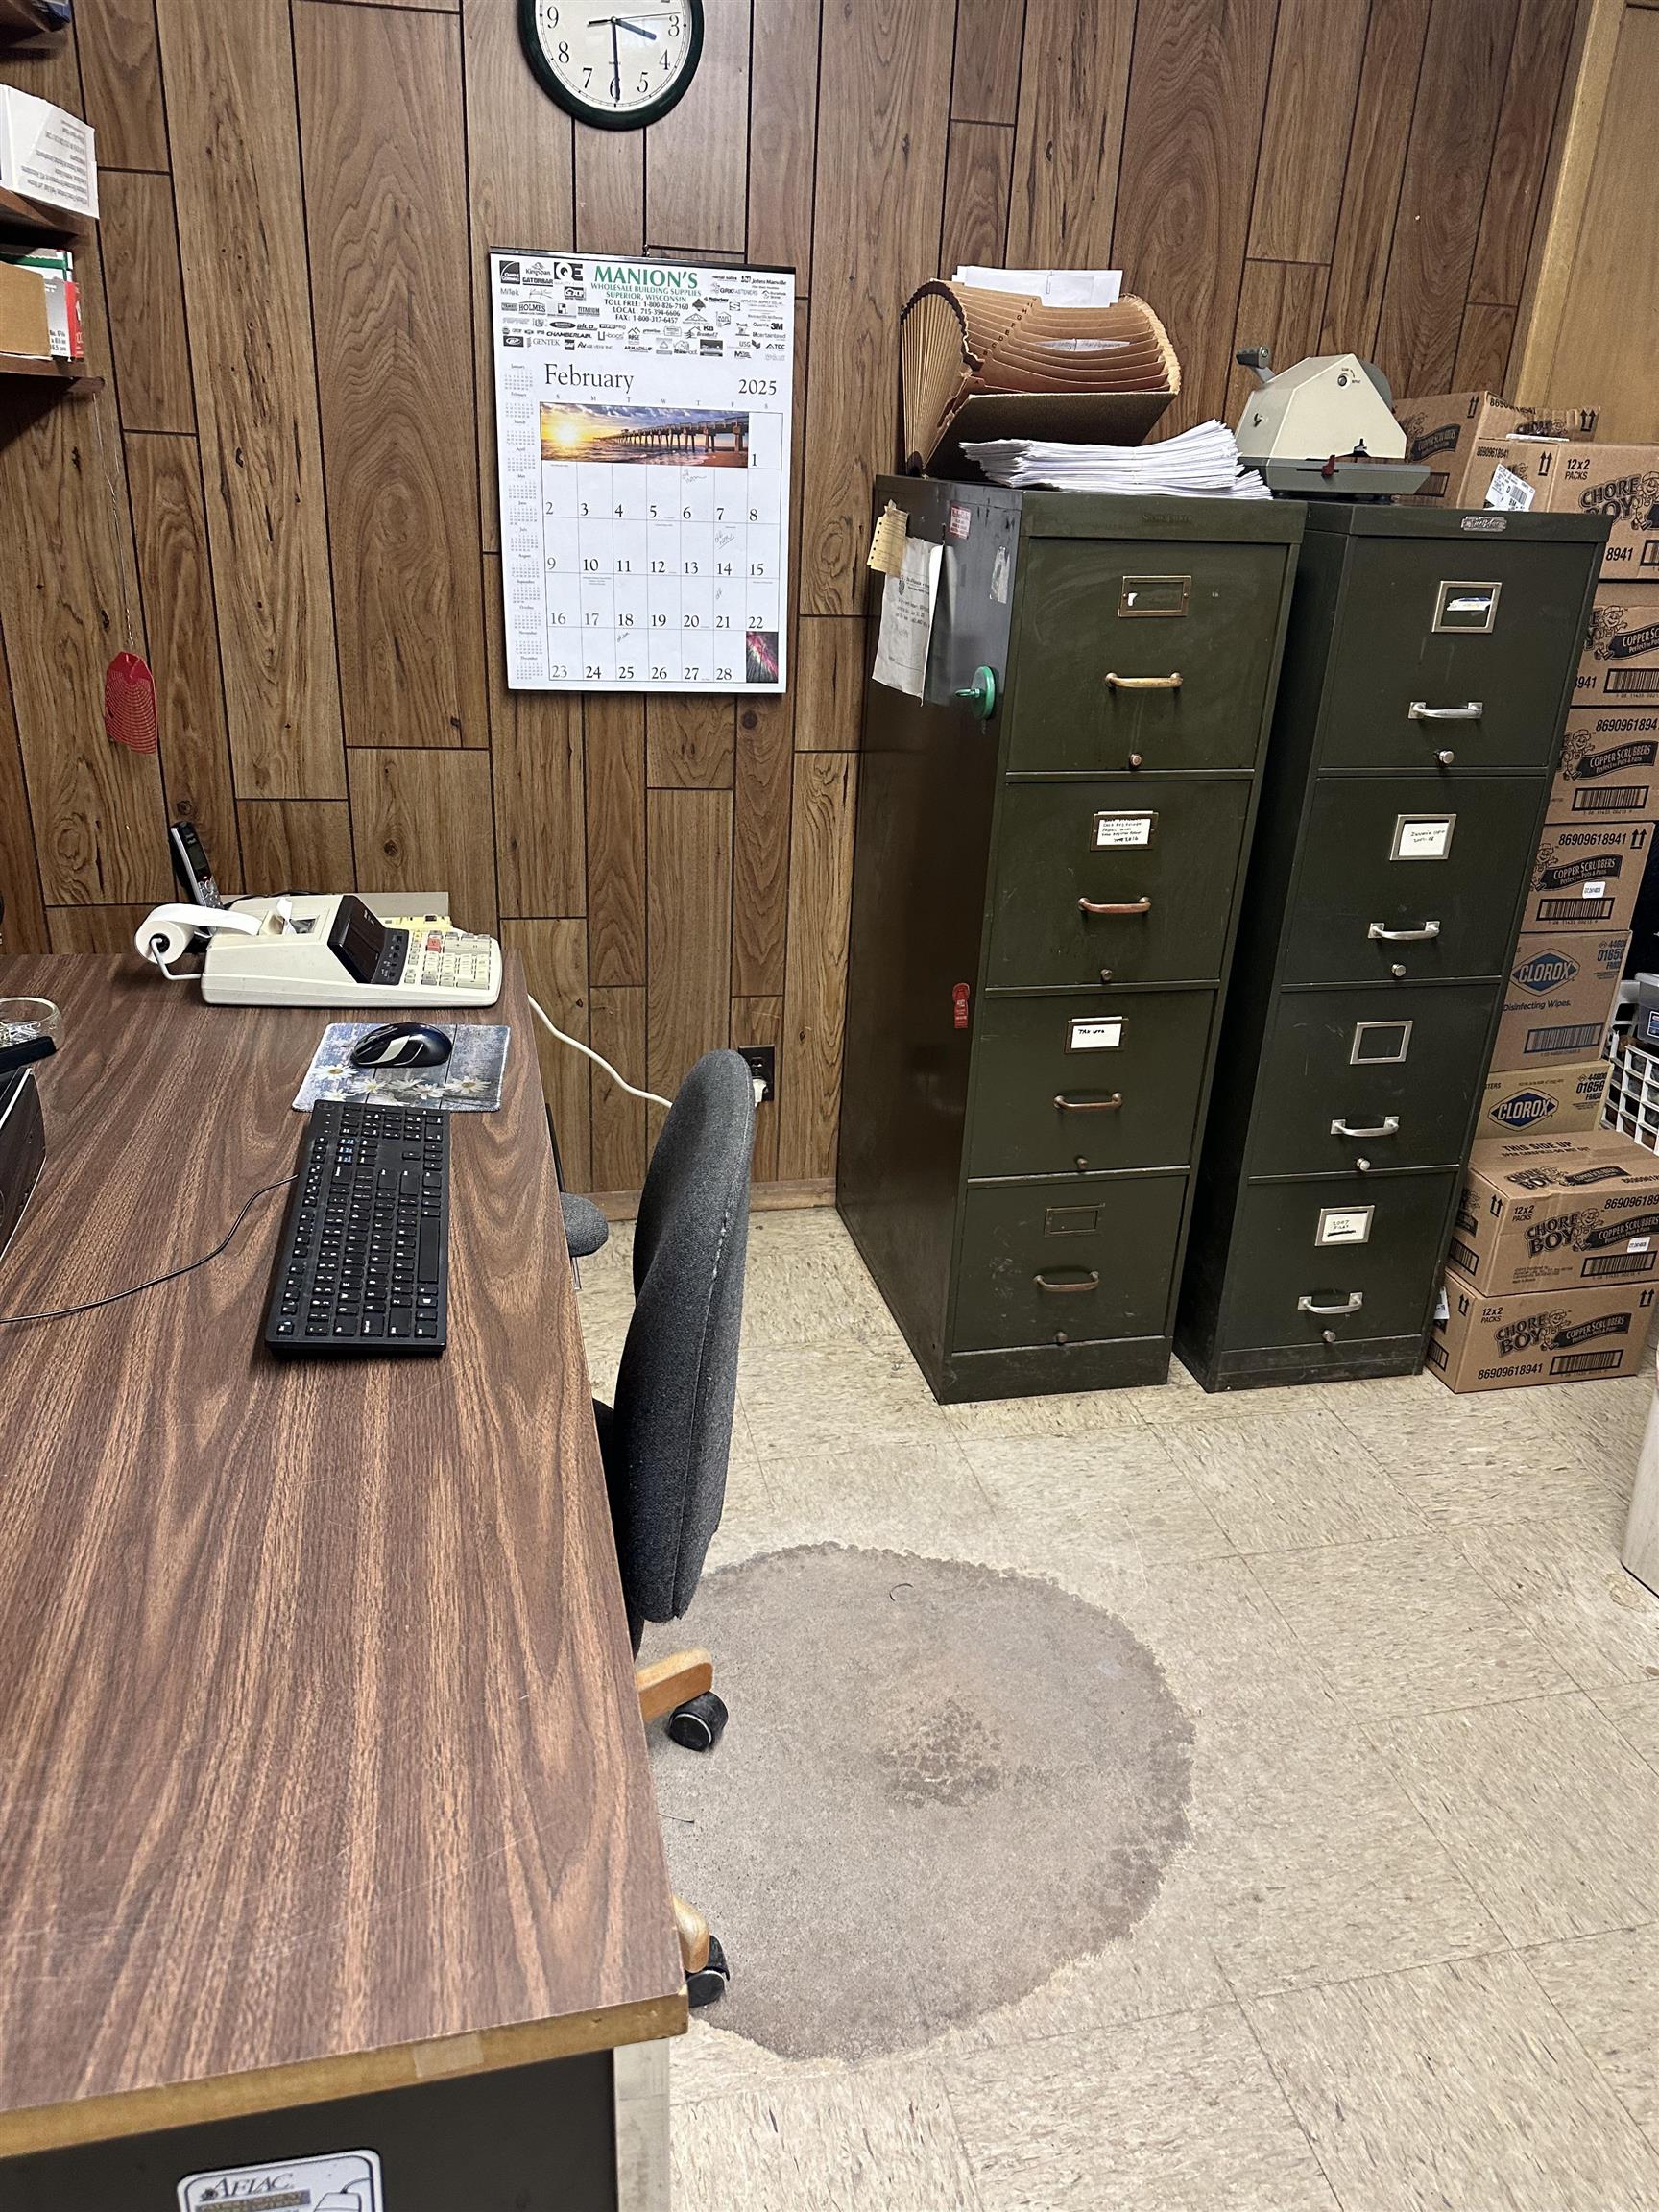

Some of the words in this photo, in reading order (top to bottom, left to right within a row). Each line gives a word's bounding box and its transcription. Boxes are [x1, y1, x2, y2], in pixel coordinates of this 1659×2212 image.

[547, 6, 558, 28] 9
[668, 14, 680, 37] 3
[558, 41, 569, 63] 8
[659, 49, 671, 70] 4
[582, 67, 592, 89] 7
[637, 72, 648, 93] 5
[595, 265, 698, 289] MANION'S
[591, 283, 632, 292] WHOLESALE
[635, 286, 668, 295] BUILDING
[670, 288, 702, 297] SUPPLIES
[544, 363, 634, 394] February
[738, 378, 777, 396] 2025
[752, 453, 757, 467] 1
[1566, 459, 1591, 470] 12x2
[1565, 471, 1588, 480] PACKS
[1580, 474, 1642, 508] CHORE
[546, 502, 553, 515] 2
[581, 503, 588, 516] 3
[615, 504, 623, 517] 4
[650, 505, 657, 517] 5
[684, 507, 691, 519] 6
[717, 508, 724, 520] 7
[750, 509, 757, 521] 8
[1605, 547, 1634, 561] 8941
[547, 558, 556, 570] 9
[584, 559, 598, 571] 10
[617, 560, 631, 572] 11
[651, 561, 665, 573] 12
[685, 562, 698, 574] 13
[718, 563, 732, 575] 14
[751, 564, 763, 576] 15
[552, 613, 565, 624] 16
[586, 613, 599, 626] 17
[619, 614, 633, 626] 18
[652, 614, 666, 627] 19
[684, 615, 699, 627] 20
[716, 616, 730, 628] 21
[749, 616, 763, 629] 22
[1623, 631, 1650, 647] COPPER
[553, 665, 567, 678] 23
[586, 666, 601, 679] 24
[619, 666, 634, 679] 25
[652, 667, 667, 680] 26
[685, 668, 699, 680] 27
[716, 668, 732, 680] 28
[1596, 718, 1659, 732] 8690961894
[1589, 752, 1616, 768] COPPER
[1616, 744, 1651, 760] SCRUBBERS
[1558, 833, 1627, 846] 86909618941
[1553, 865, 1580, 880] COPPER
[1580, 858, 1616, 872] SCRUBBERS
[1518, 961, 1574, 984] CLOROX
[1503, 1000, 1546, 1012] Disinfecting
[1498, 1099, 1551, 1120] CLOROX
[1502, 1142, 1528, 1152] THIS
[1530, 1142, 1554, 1150] SIDE
[1514, 1205, 1535, 1215] 12x2
[1525, 1211, 1580, 1242] CHORE
[1599, 1224, 1625, 1239] COPPER
[1528, 1227, 1576, 1259] BOY
[1480, 1315, 1502, 1324] PACKS
[1482, 1307, 1503, 1316] 12x2
[1494, 1311, 1549, 1342] CHORE
[1566, 1324, 1592, 1340] COPPER
[1497, 1328, 1545, 1358] BOY
[1478, 1363, 1544, 1380] 86909618941
